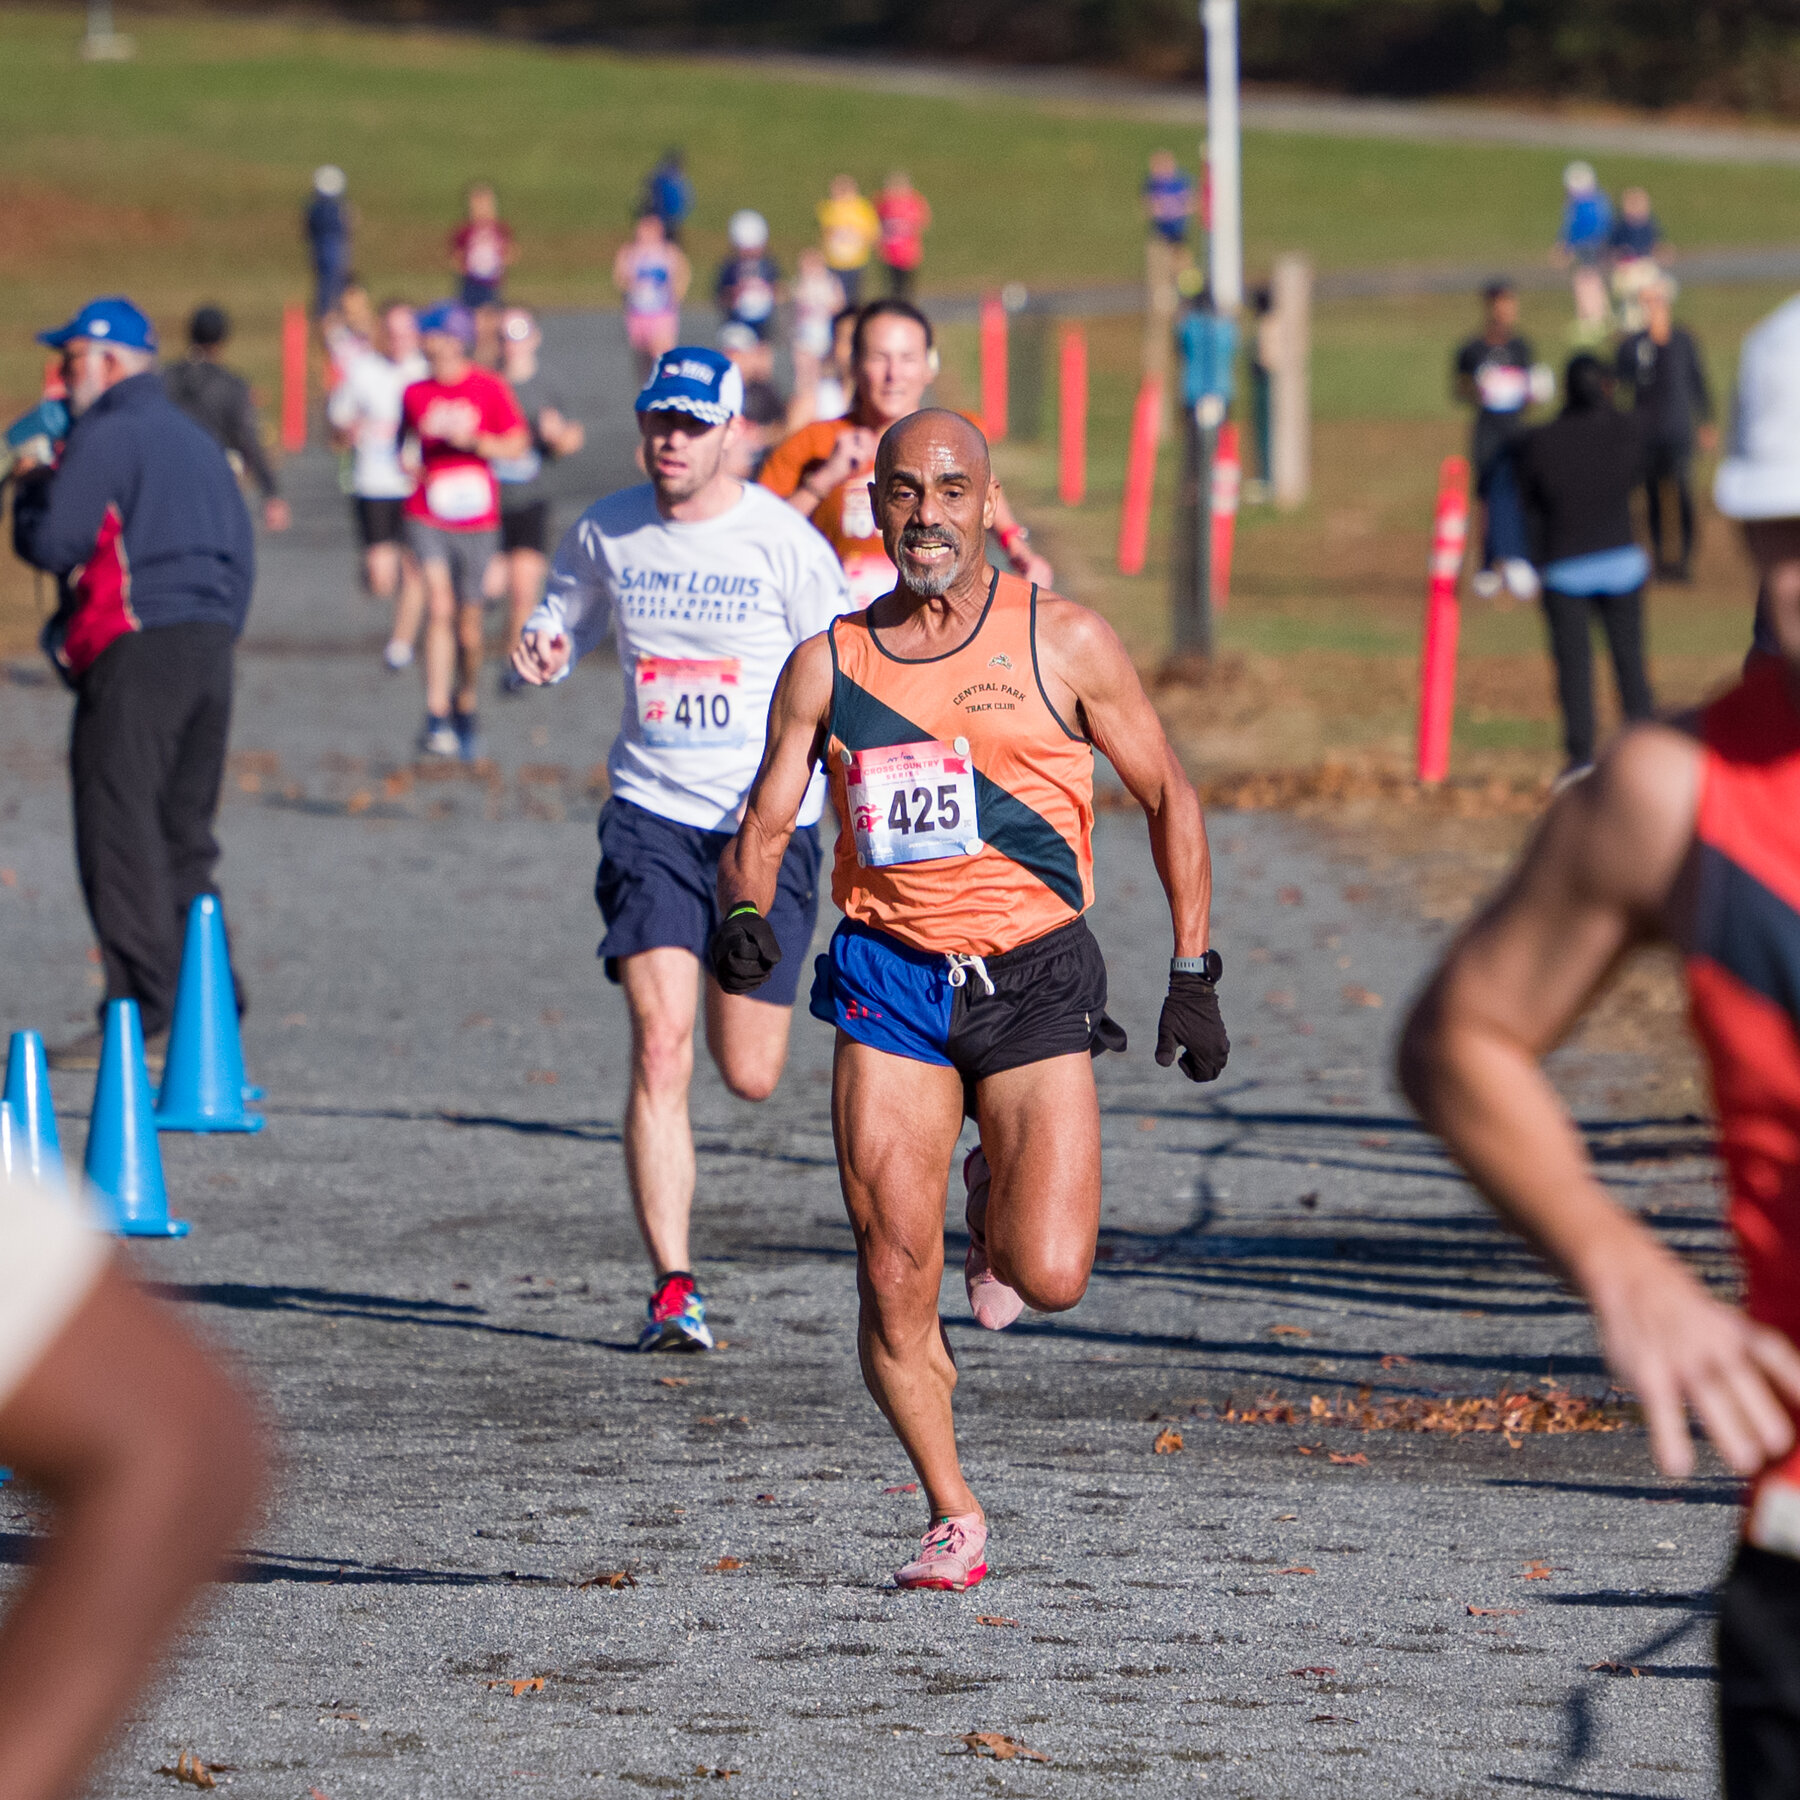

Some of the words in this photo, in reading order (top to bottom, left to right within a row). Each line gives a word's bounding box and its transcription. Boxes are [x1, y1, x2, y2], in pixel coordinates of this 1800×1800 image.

[619, 567, 684, 592] SAINT
[687, 570, 763, 597] LOUIS
[953, 683, 998, 706] CENTRAL
[1001, 684, 1026, 702] PARK
[674, 694, 730, 730] 410
[965, 703, 992, 714] TRACK
[994, 702, 1016, 711] CLUB
[863, 763, 894, 777] CROSS
[896, 759, 940, 772] COUNTRY
[888, 784, 960, 835] 425
